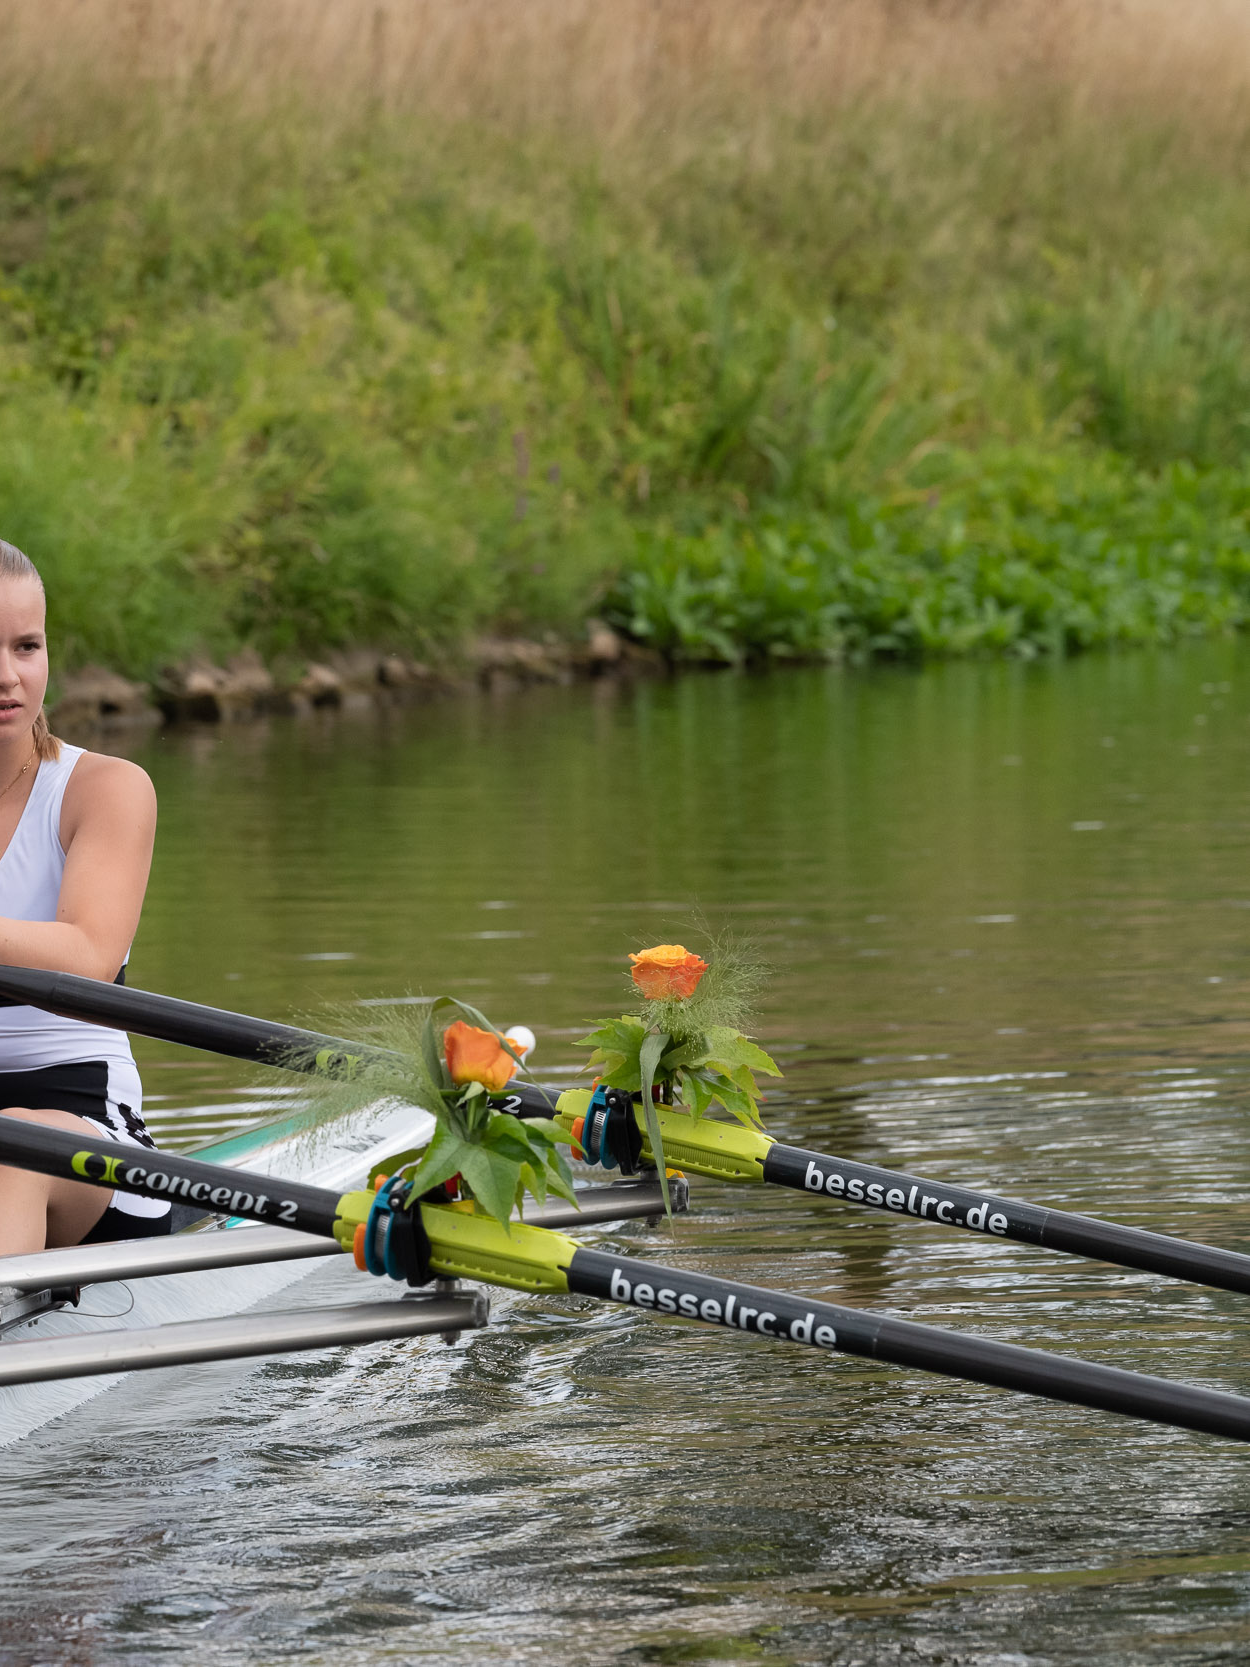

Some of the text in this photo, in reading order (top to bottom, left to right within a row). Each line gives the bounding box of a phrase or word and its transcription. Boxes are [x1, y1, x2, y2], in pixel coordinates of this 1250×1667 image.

[503, 1094, 523, 1114] 2
[125, 1166, 299, 1222] concept 2
[804, 1160, 1008, 1235] besselrc.de
[610, 1268, 837, 1350] besselrc.de
